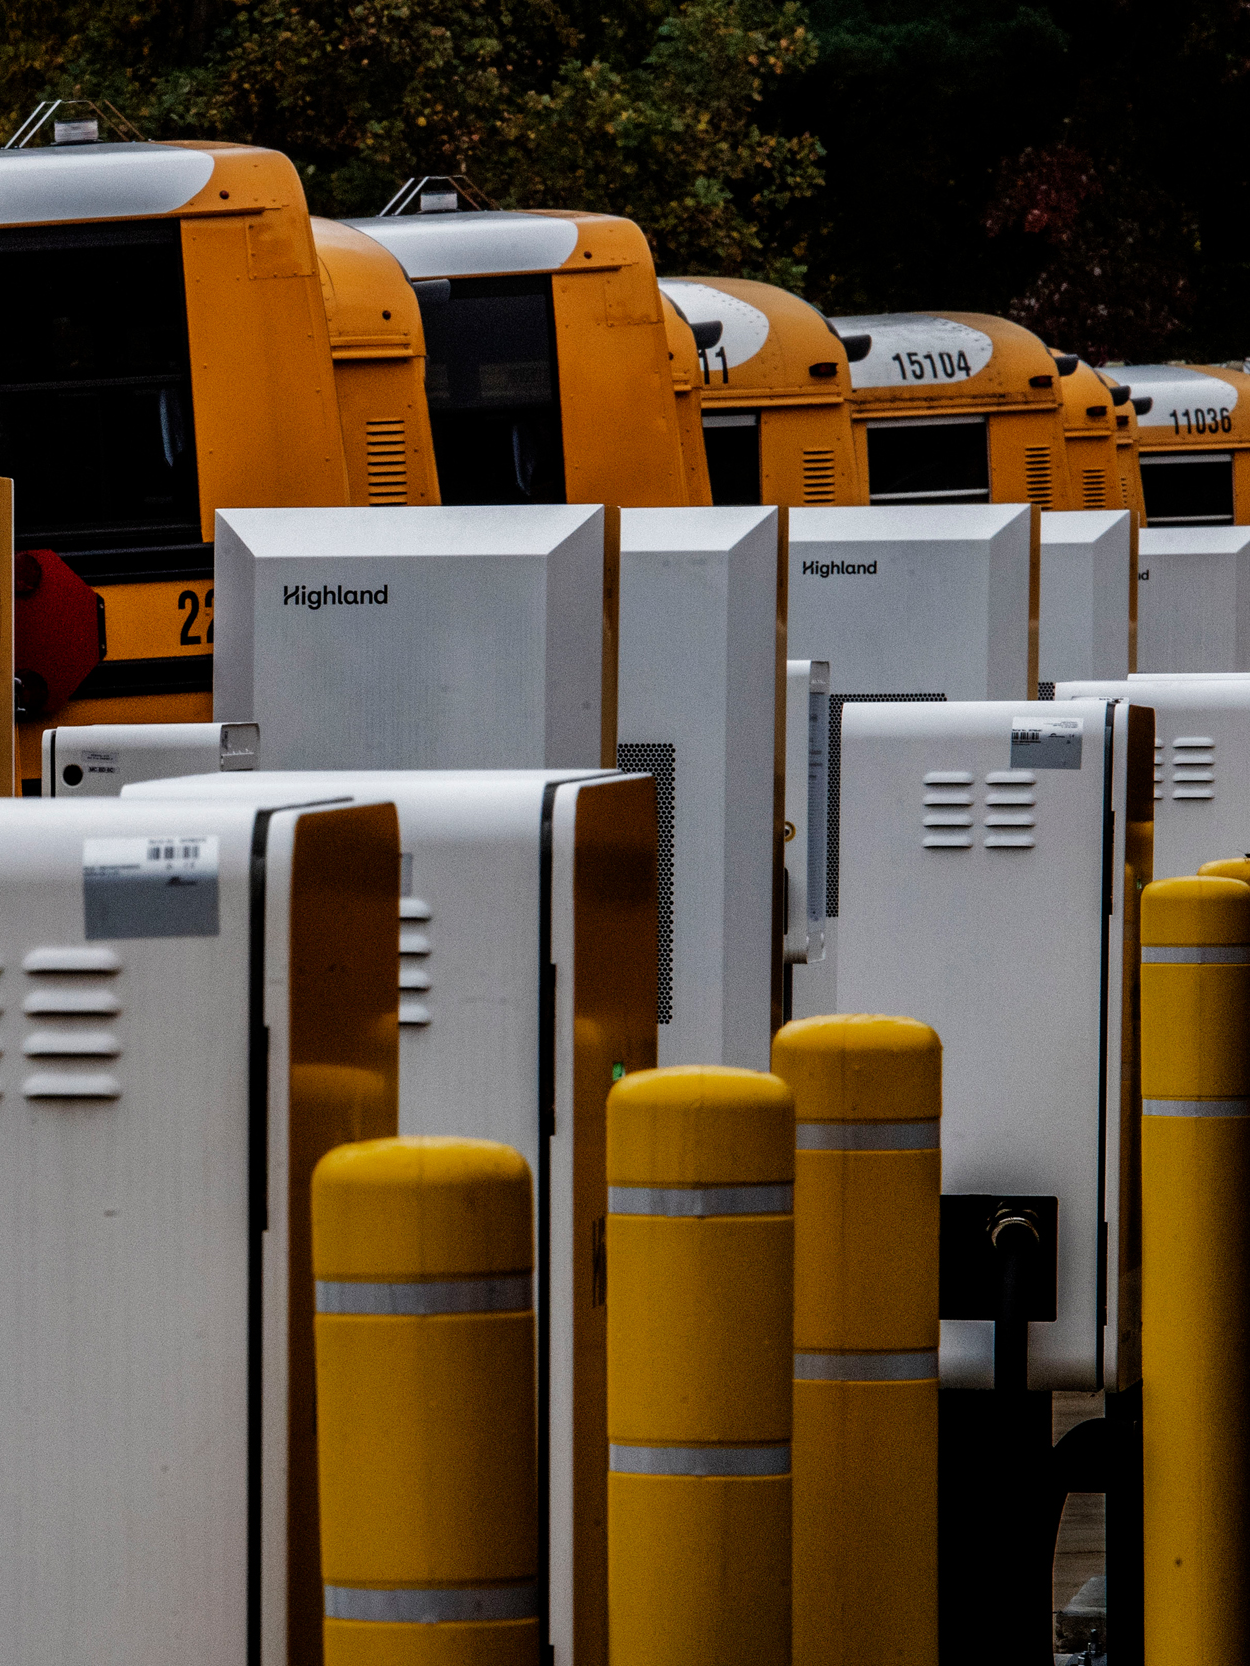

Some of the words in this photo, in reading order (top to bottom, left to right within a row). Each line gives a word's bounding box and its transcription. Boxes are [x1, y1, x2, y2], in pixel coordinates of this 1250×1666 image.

[891, 349, 972, 381] 15104
[1169, 406, 1232, 435] 11036
[802, 560, 878, 579] Highland
[283, 584, 389, 610] Highland
